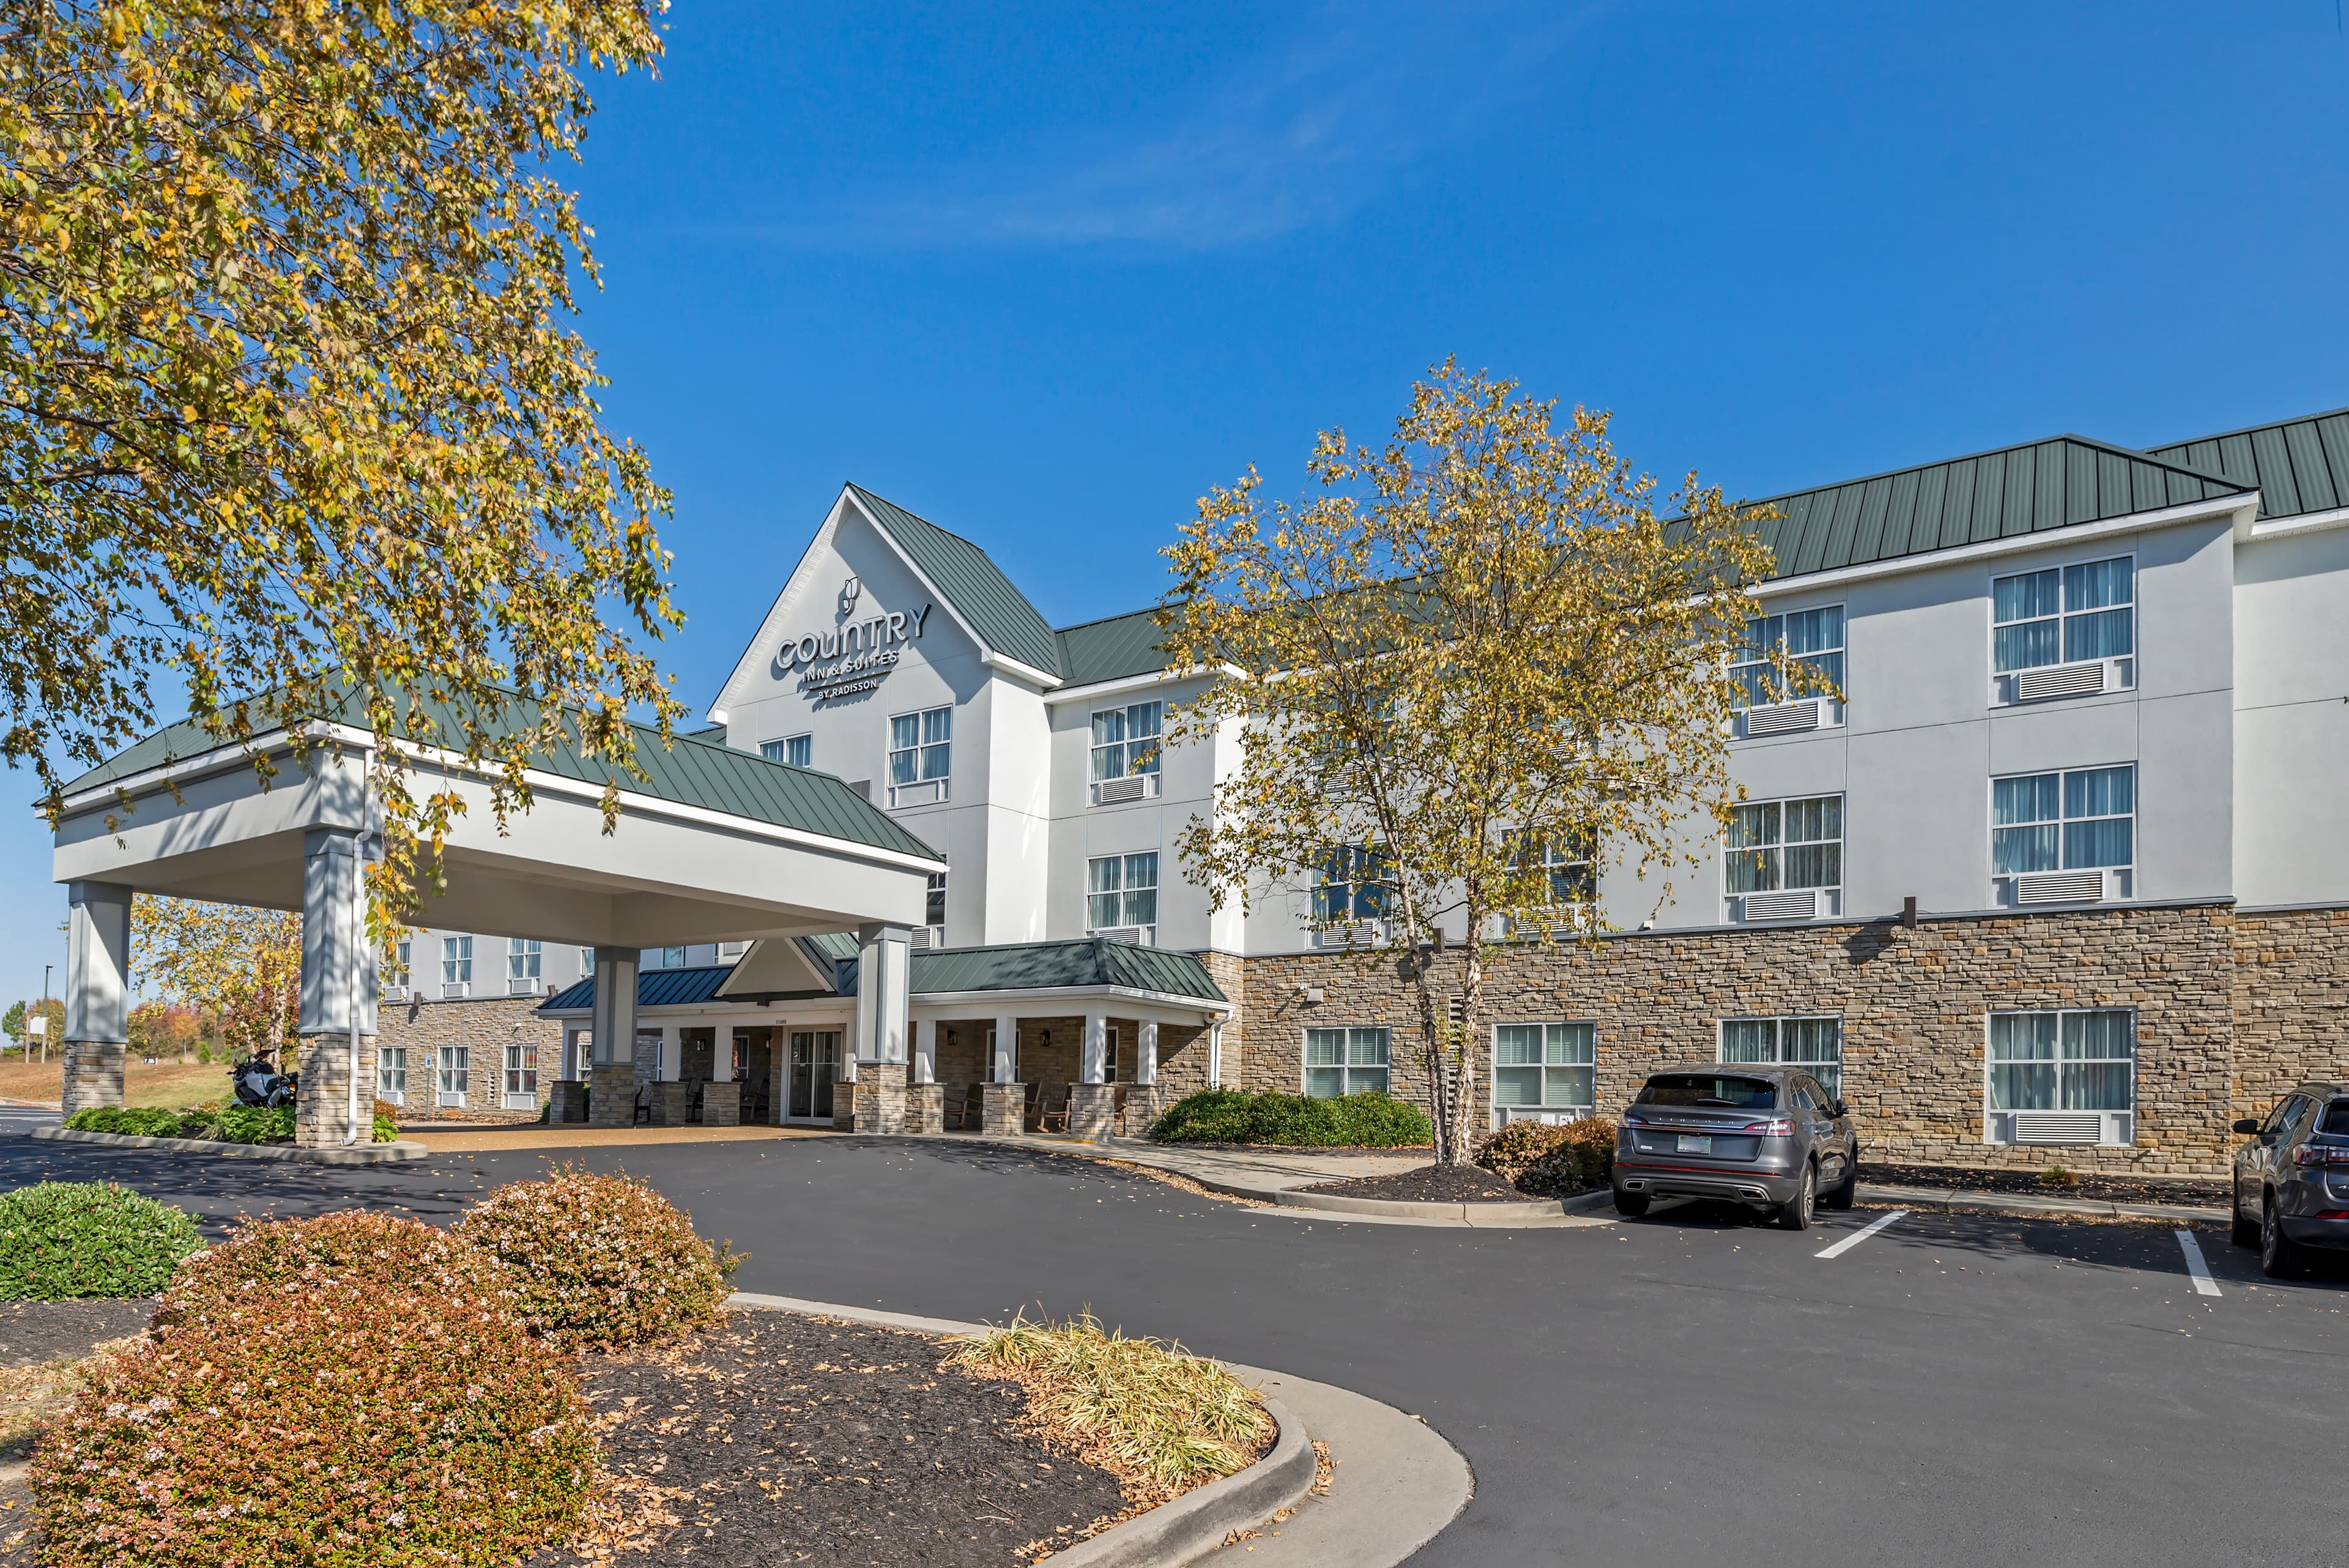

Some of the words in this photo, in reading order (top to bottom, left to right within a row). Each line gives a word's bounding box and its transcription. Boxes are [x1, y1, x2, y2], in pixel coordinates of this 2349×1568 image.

[803, 666, 826, 683] INN
[831, 664, 841, 676] &
[845, 650, 899, 673] SUITES
[818, 689, 829, 700] BY
[832, 678, 879, 697] RADISSON
